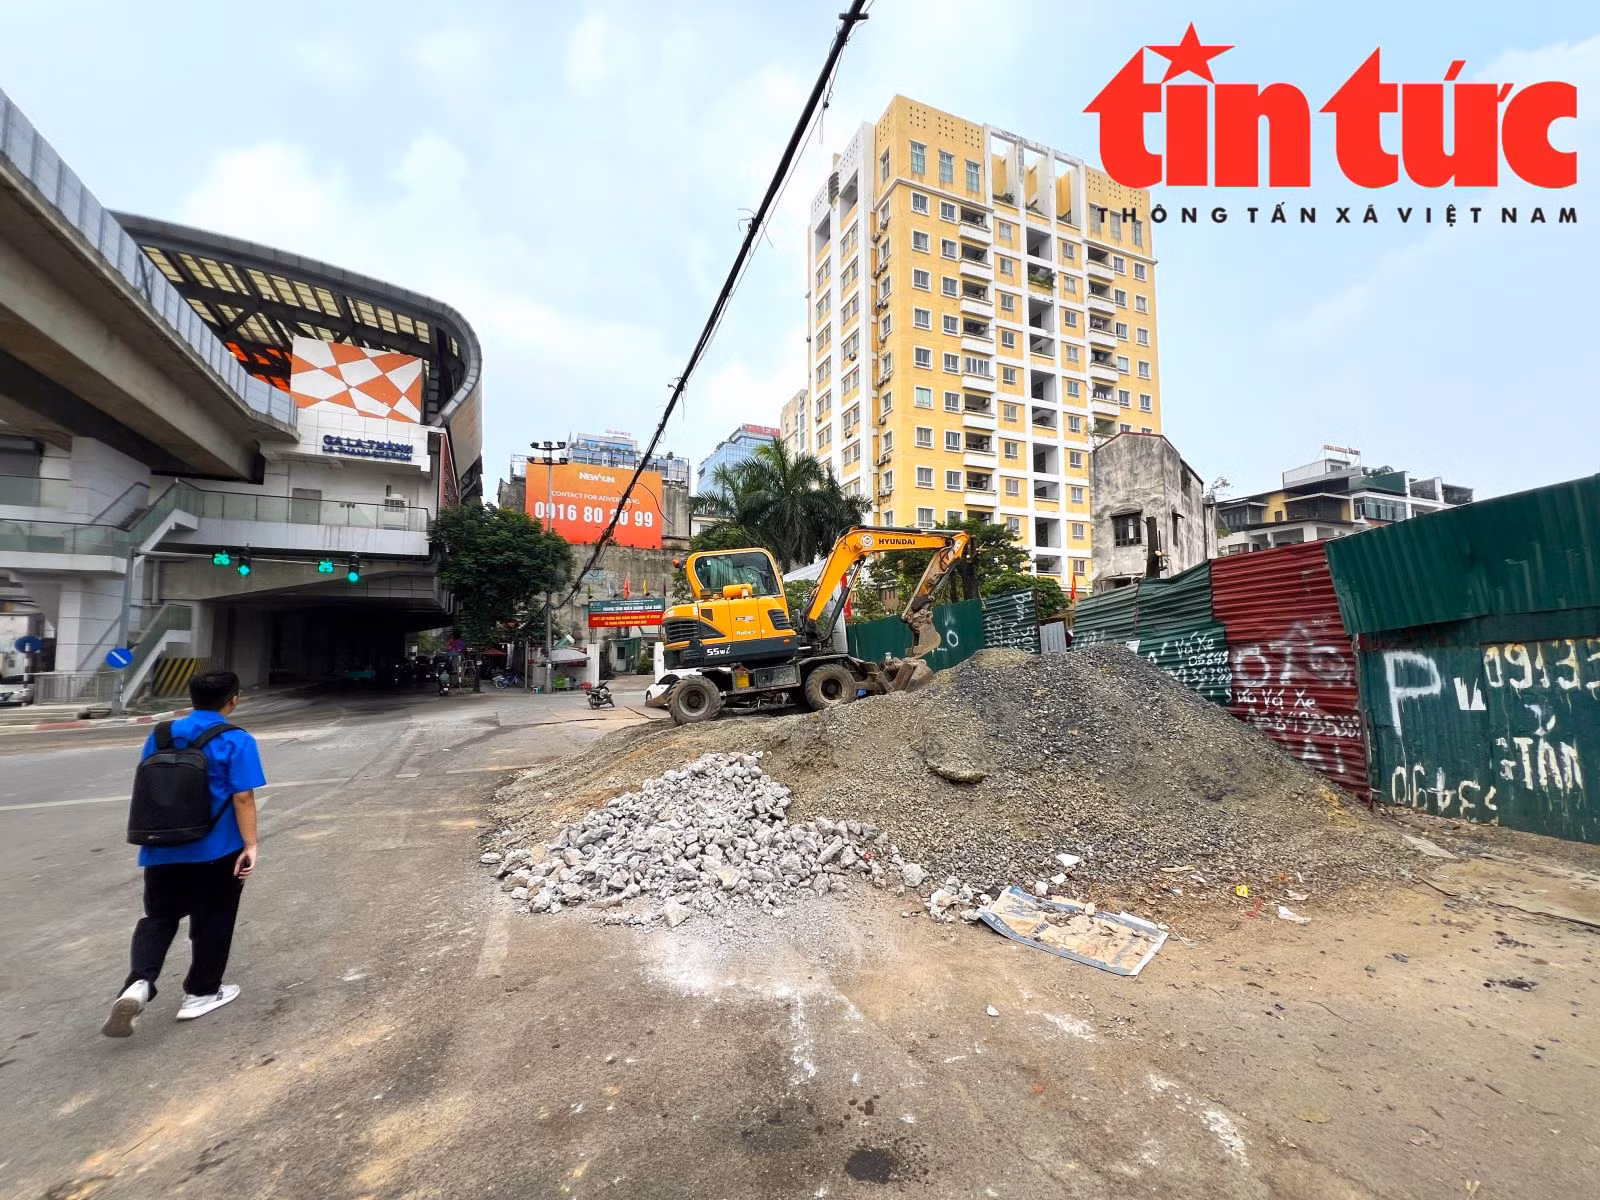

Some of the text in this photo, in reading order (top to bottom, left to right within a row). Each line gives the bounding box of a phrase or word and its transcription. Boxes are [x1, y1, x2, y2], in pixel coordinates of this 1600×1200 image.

[551, 490, 582, 499] CONTACT
[584, 493, 598, 501] FOR
[534, 501, 577, 521] 0916
[583, 506, 603, 524] 80
[634, 511, 653, 528] 99
